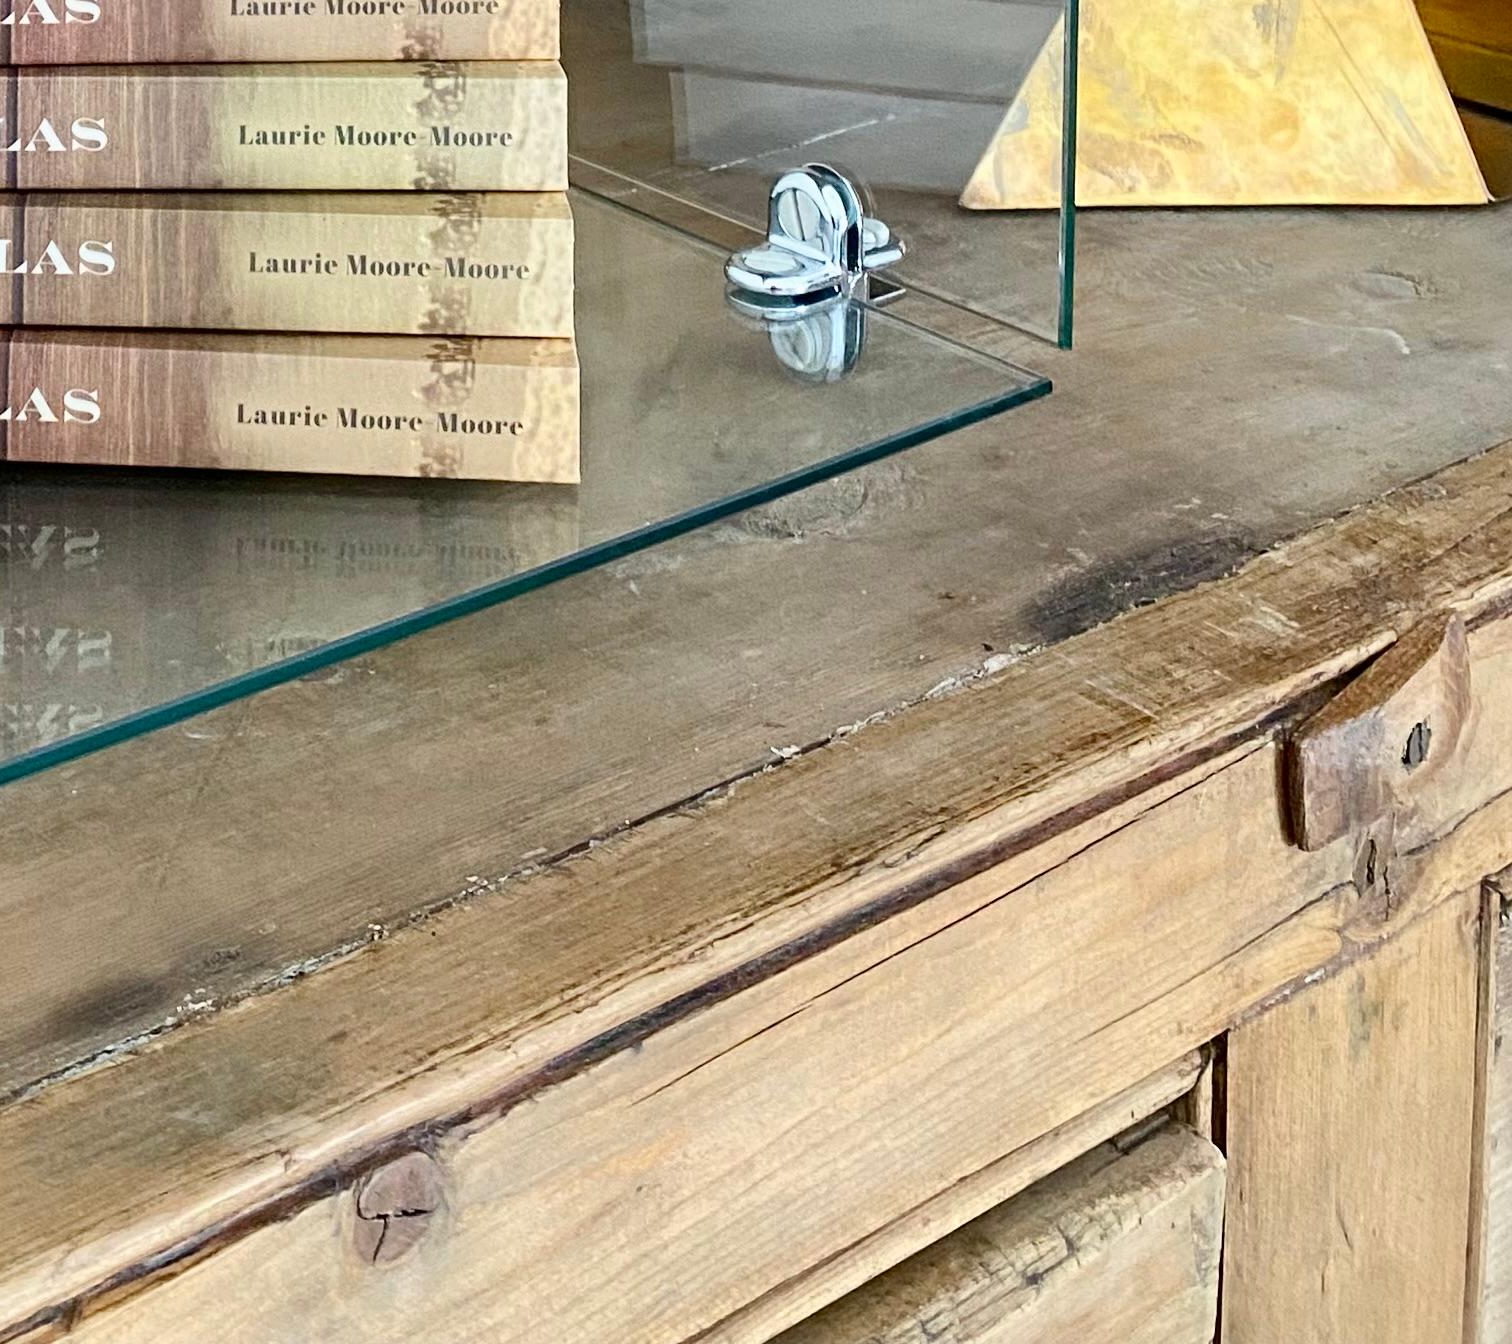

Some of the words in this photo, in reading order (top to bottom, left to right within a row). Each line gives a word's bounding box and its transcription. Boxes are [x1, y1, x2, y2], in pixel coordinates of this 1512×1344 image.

[239, 124, 326, 145] Laurie
[335, 125, 512, 147] Moore-Moore
[249, 251, 338, 275] Laurie
[347, 254, 529, 280] Moore-Moore
[237, 403, 328, 427] Laurie
[337, 407, 523, 436] Moore-Moore
